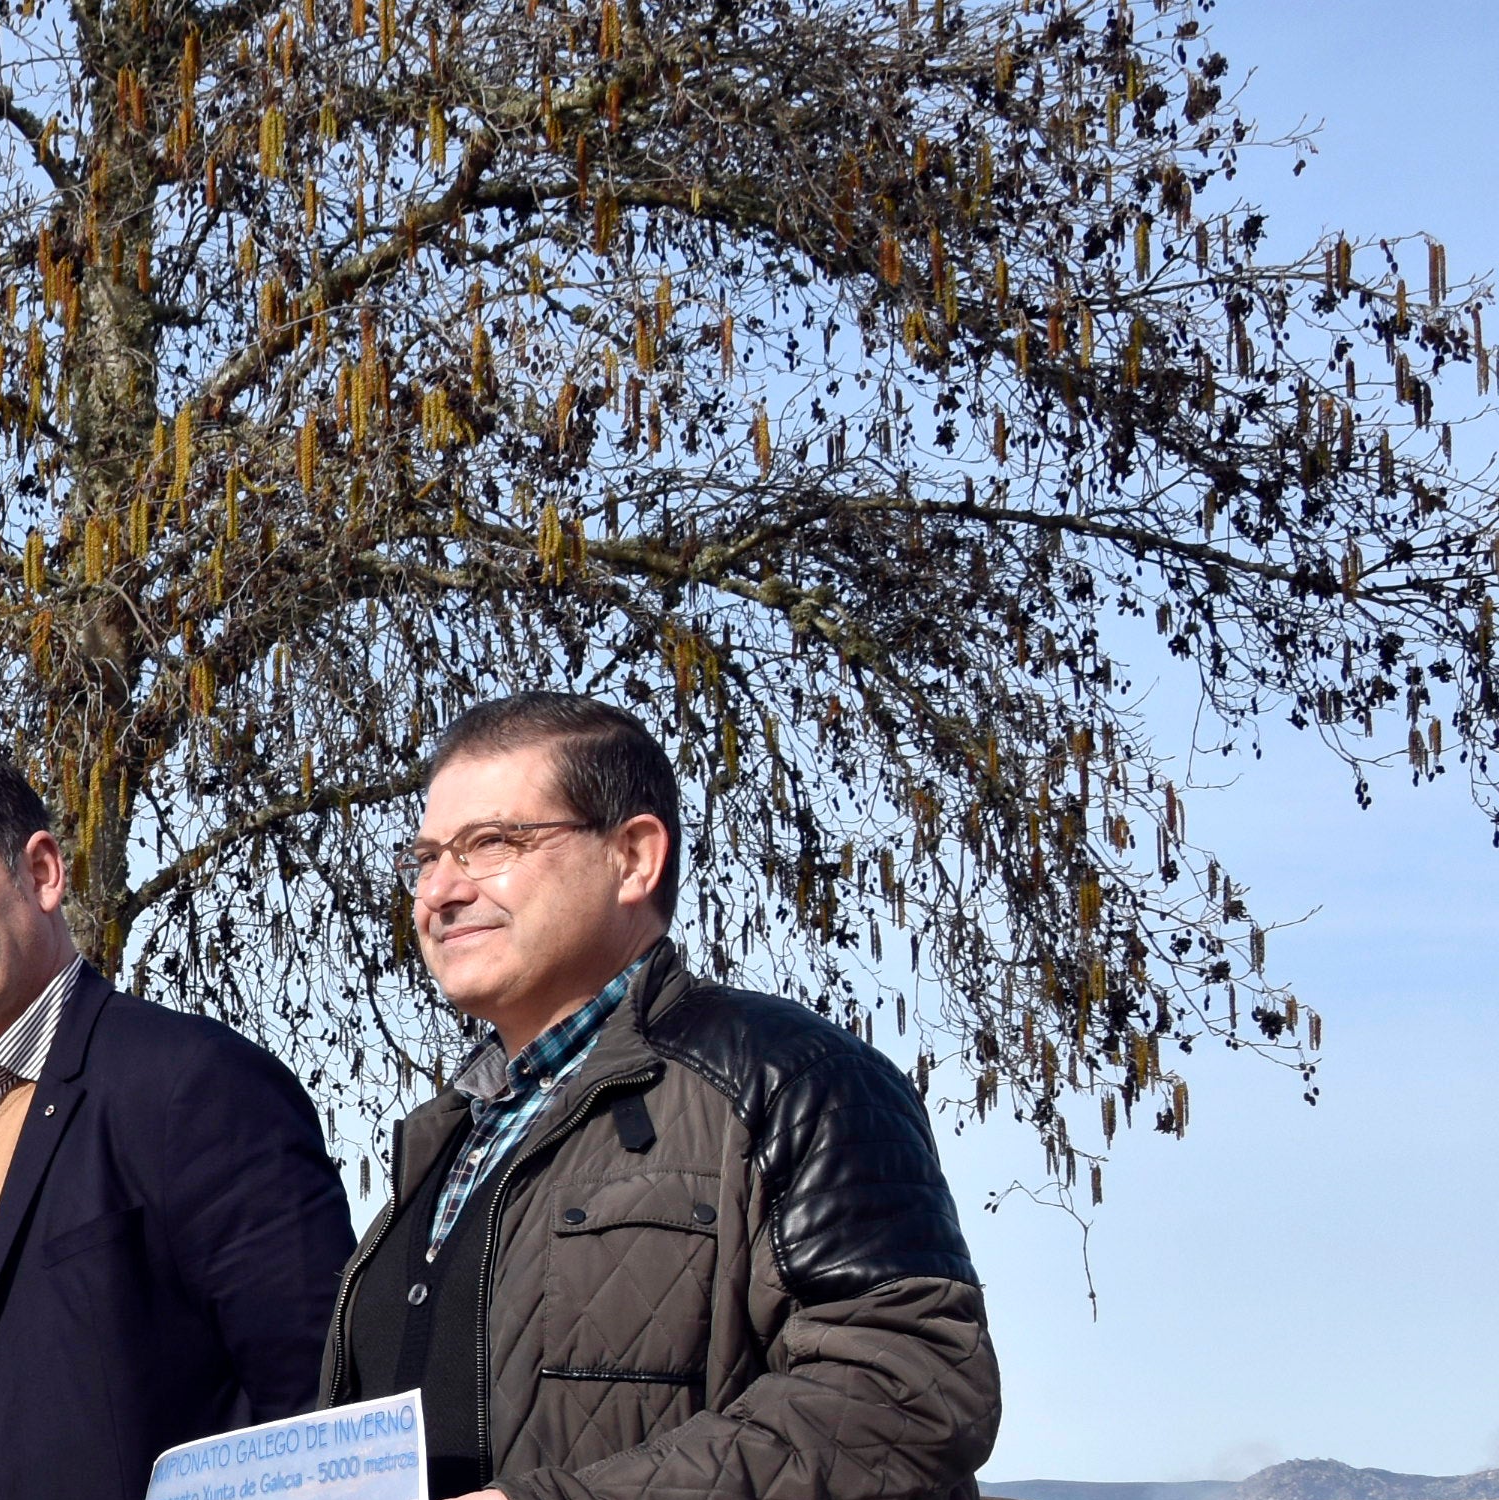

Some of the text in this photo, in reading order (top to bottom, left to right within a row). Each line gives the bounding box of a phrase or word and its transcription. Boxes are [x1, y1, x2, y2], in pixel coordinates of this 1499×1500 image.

[154, 1405, 415, 1483] MPIONATO GALEGO DE INVERNO
[239, 1476, 257, 1497] de
[259, 1470, 303, 1494] Galicia
[317, 1455, 360, 1484] 5000
[364, 1450, 419, 1475] metros
